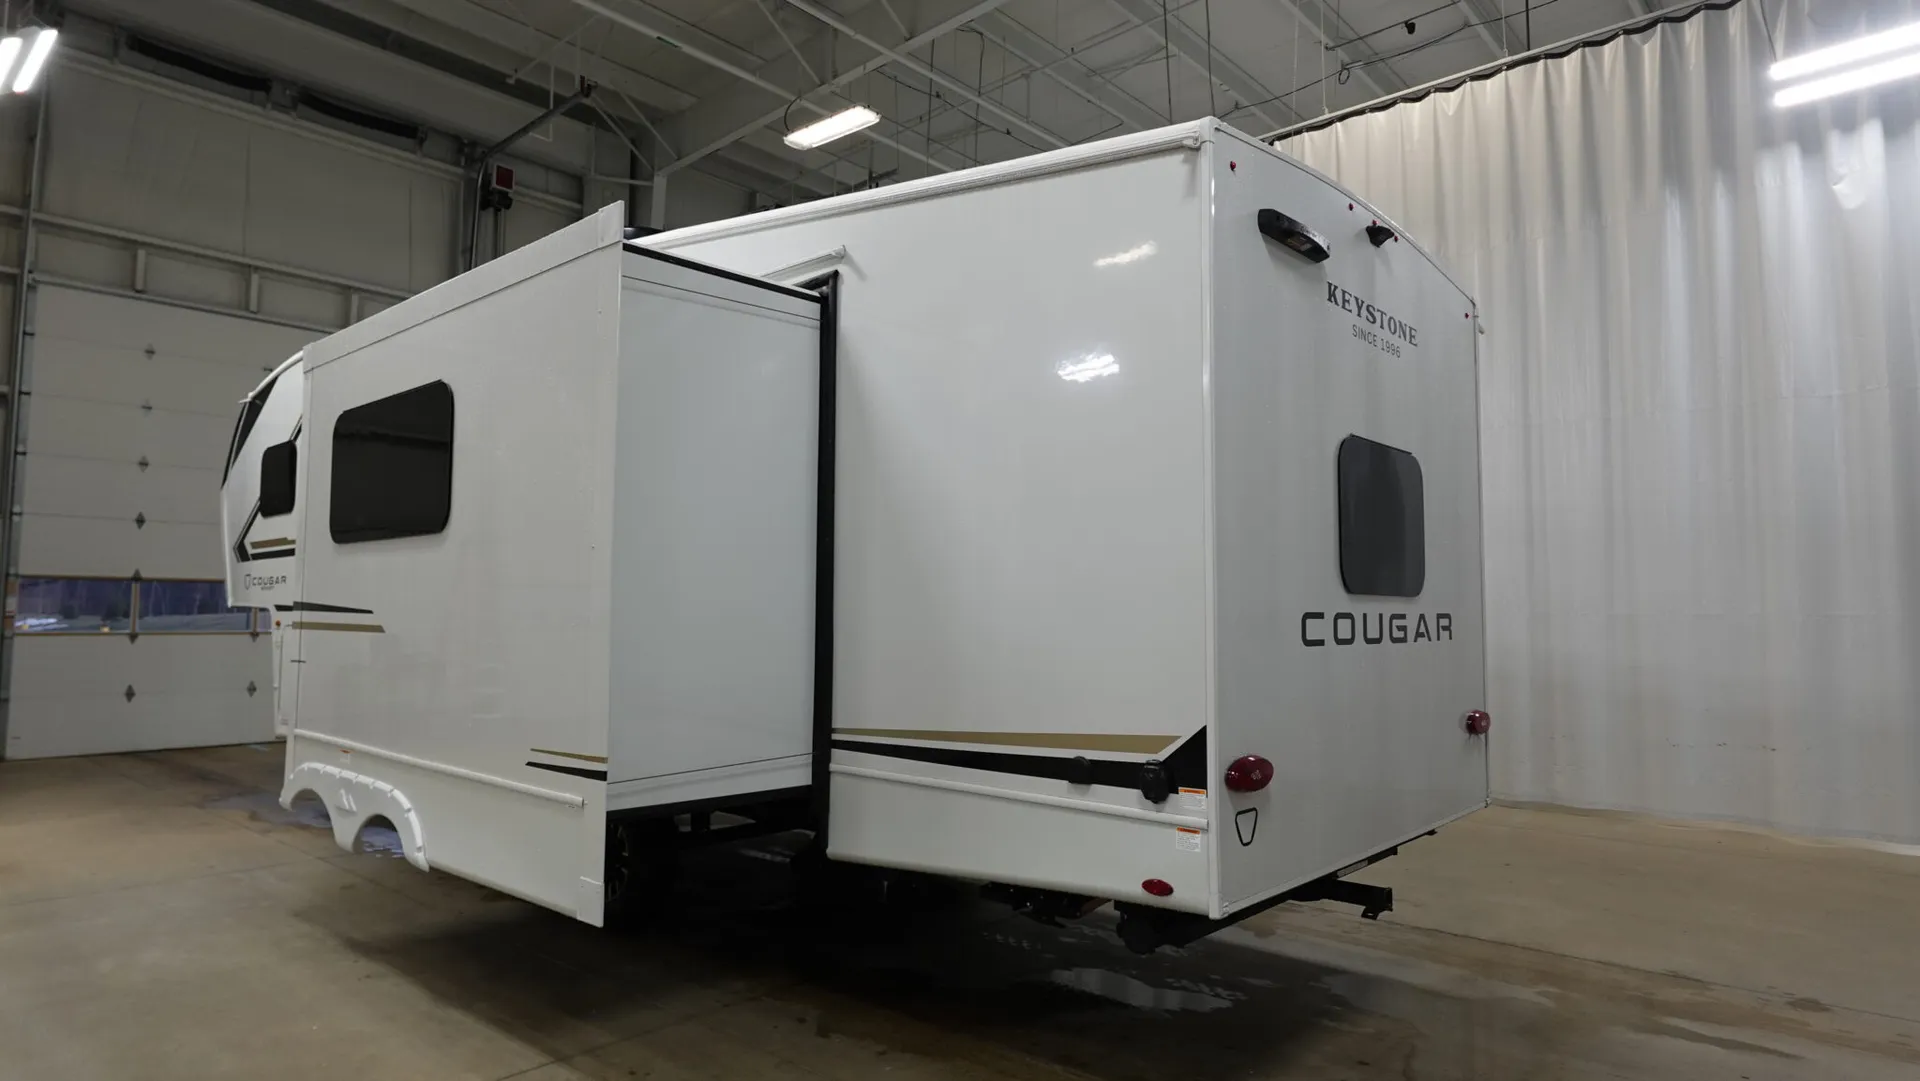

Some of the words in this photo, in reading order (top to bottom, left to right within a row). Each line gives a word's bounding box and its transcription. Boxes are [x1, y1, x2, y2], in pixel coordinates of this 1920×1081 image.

[1327, 281, 1418, 347] KEYSTONE
[1352, 324, 1378, 348] SINCE
[1381, 338, 1401, 358] 1996
[252, 575, 287, 586] COUGAR
[1301, 611, 1453, 647] COUGAR
